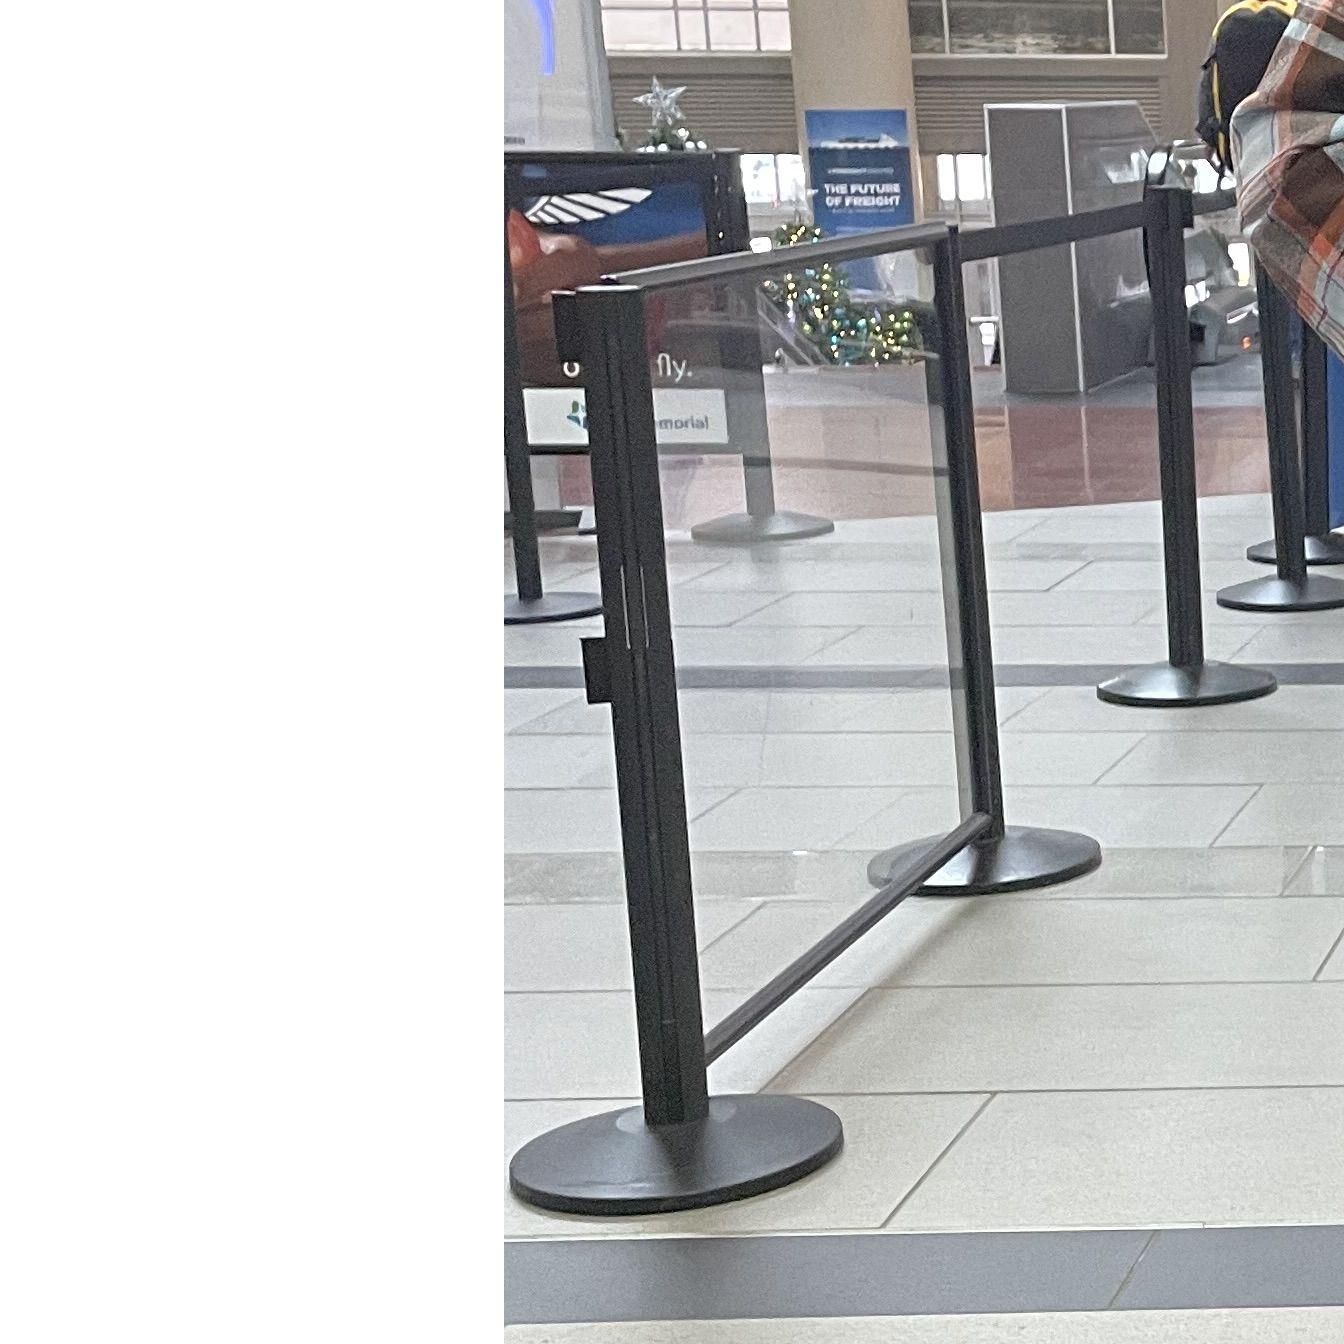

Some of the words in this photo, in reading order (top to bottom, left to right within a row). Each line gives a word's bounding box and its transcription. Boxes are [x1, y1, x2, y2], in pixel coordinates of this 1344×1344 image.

[824, 183, 848, 195] THE
[850, 183, 901, 194] FUTURE
[825, 196, 843, 206] OF
[844, 196, 901, 207] FREIGHT
[655, 416, 709, 431] morial
